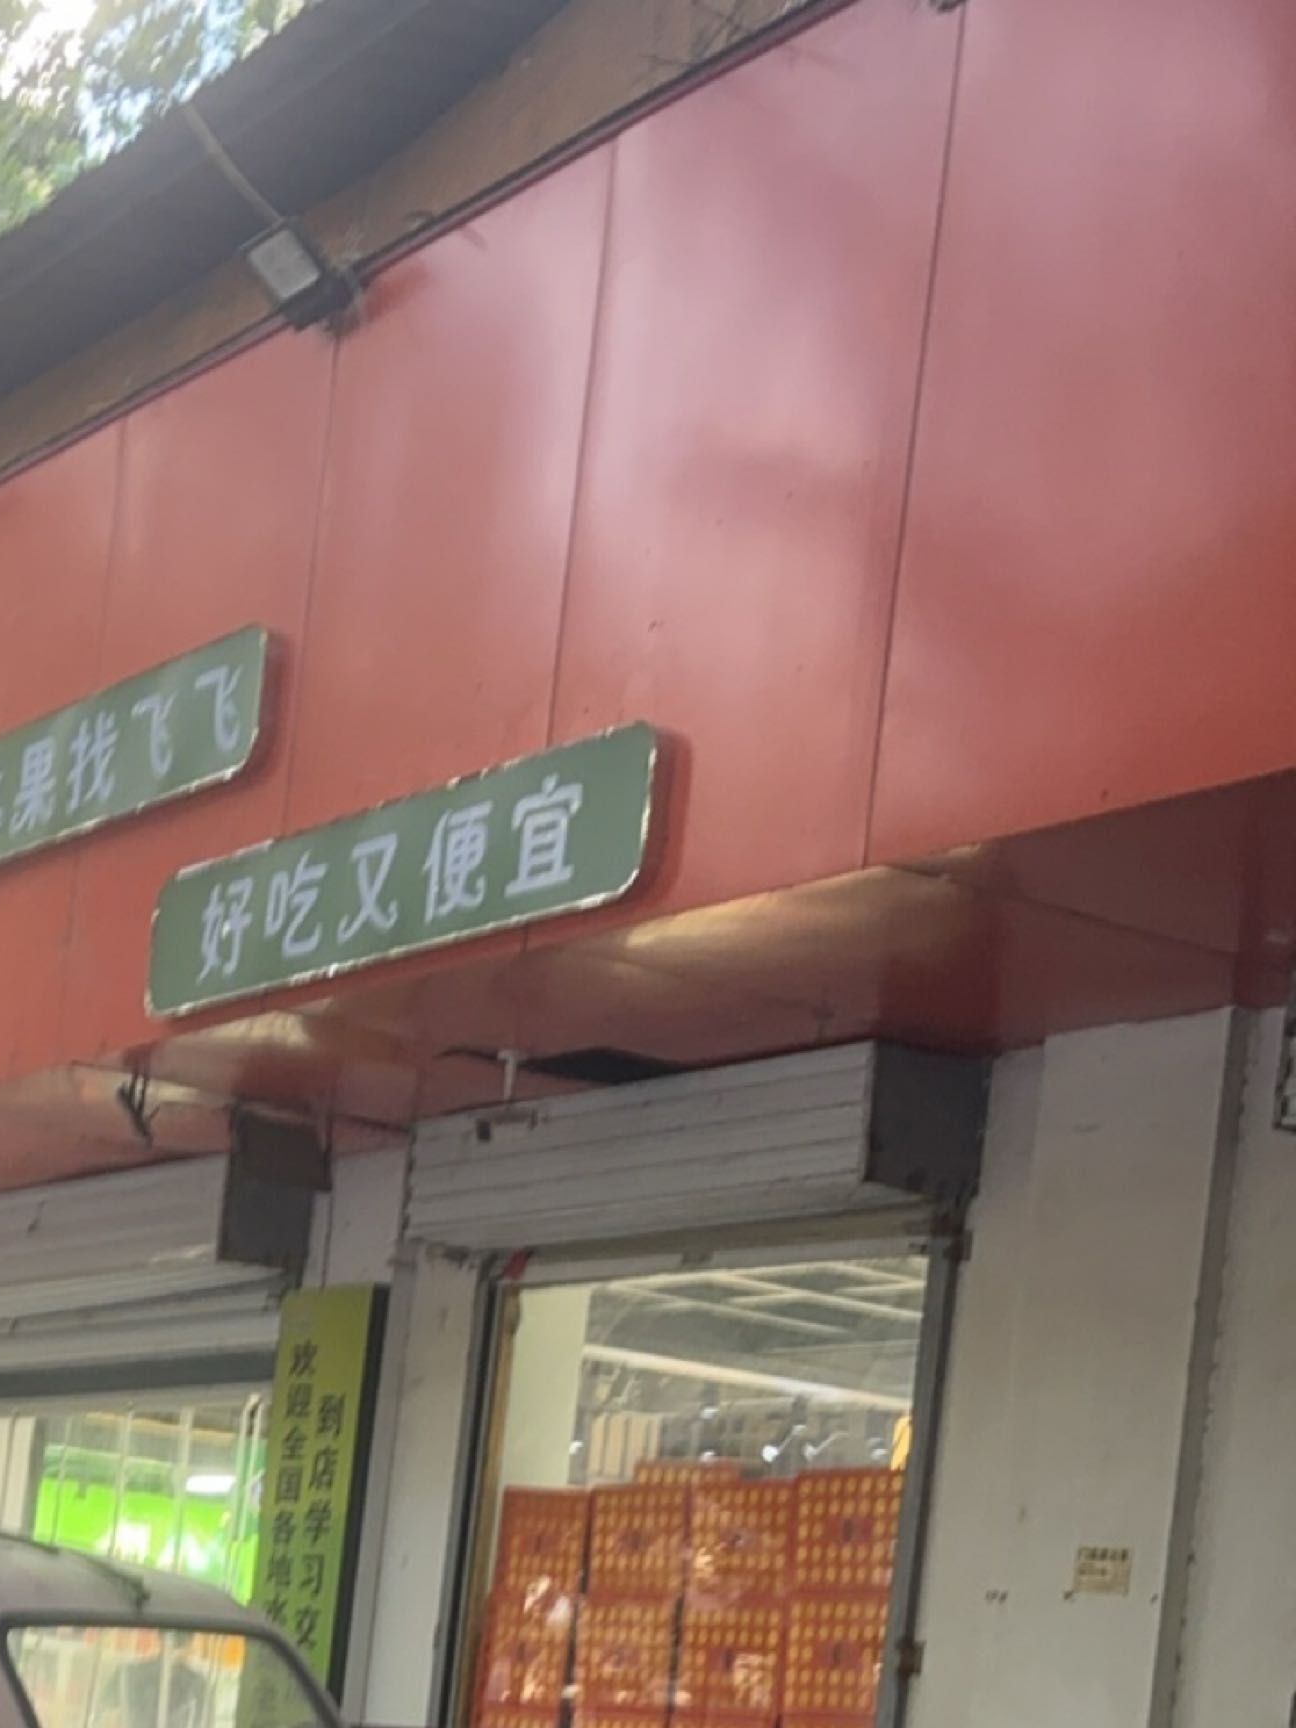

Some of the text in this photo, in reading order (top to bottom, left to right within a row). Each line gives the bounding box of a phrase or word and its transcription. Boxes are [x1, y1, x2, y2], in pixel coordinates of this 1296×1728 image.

[194, 771, 584, 985] 好吃又便宜
